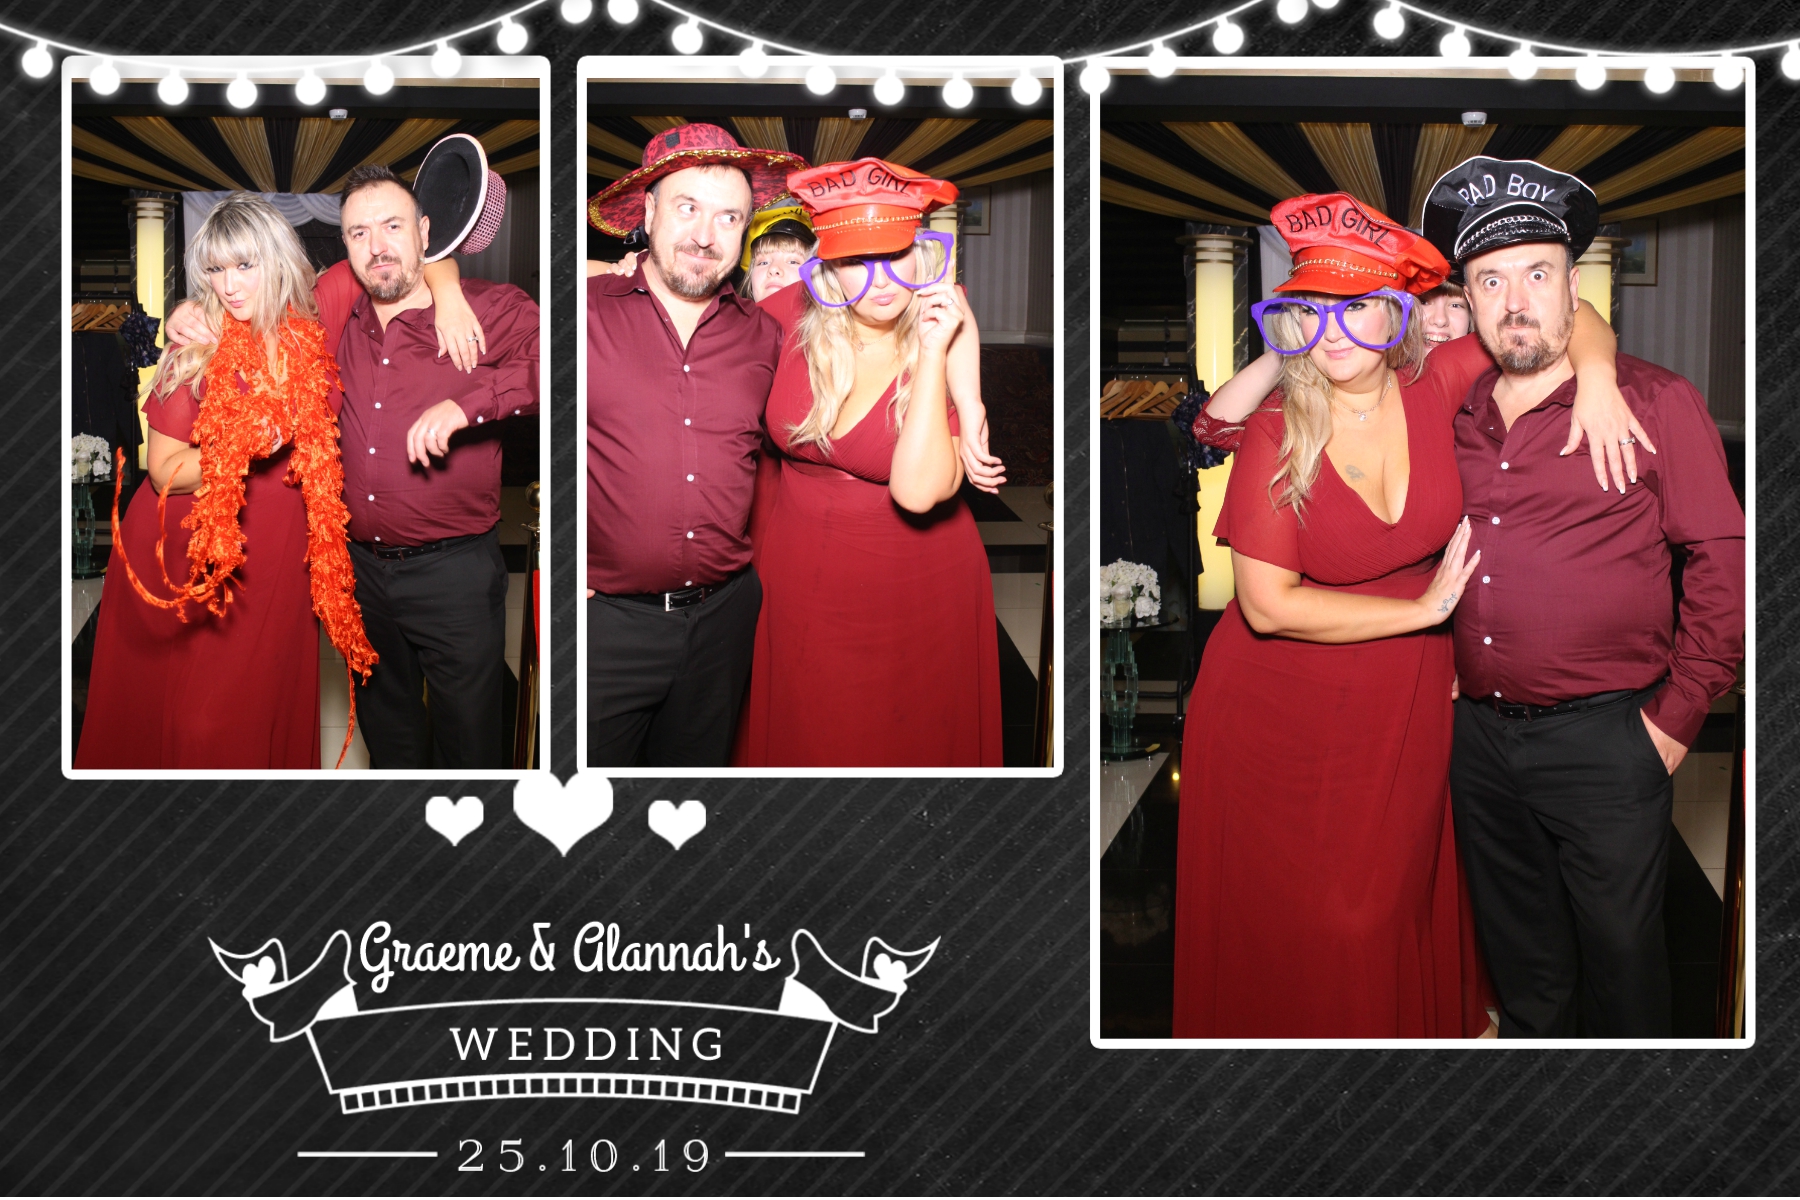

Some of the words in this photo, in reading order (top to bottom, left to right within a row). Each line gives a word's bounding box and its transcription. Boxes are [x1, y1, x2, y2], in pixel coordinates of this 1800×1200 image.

[807, 169, 857, 198] BAD
[1457, 174, 1496, 207] BAD
[1506, 173, 1556, 202] BOY
[1285, 205, 1332, 233] BAD
[1341, 207, 1390, 250] GIRL
